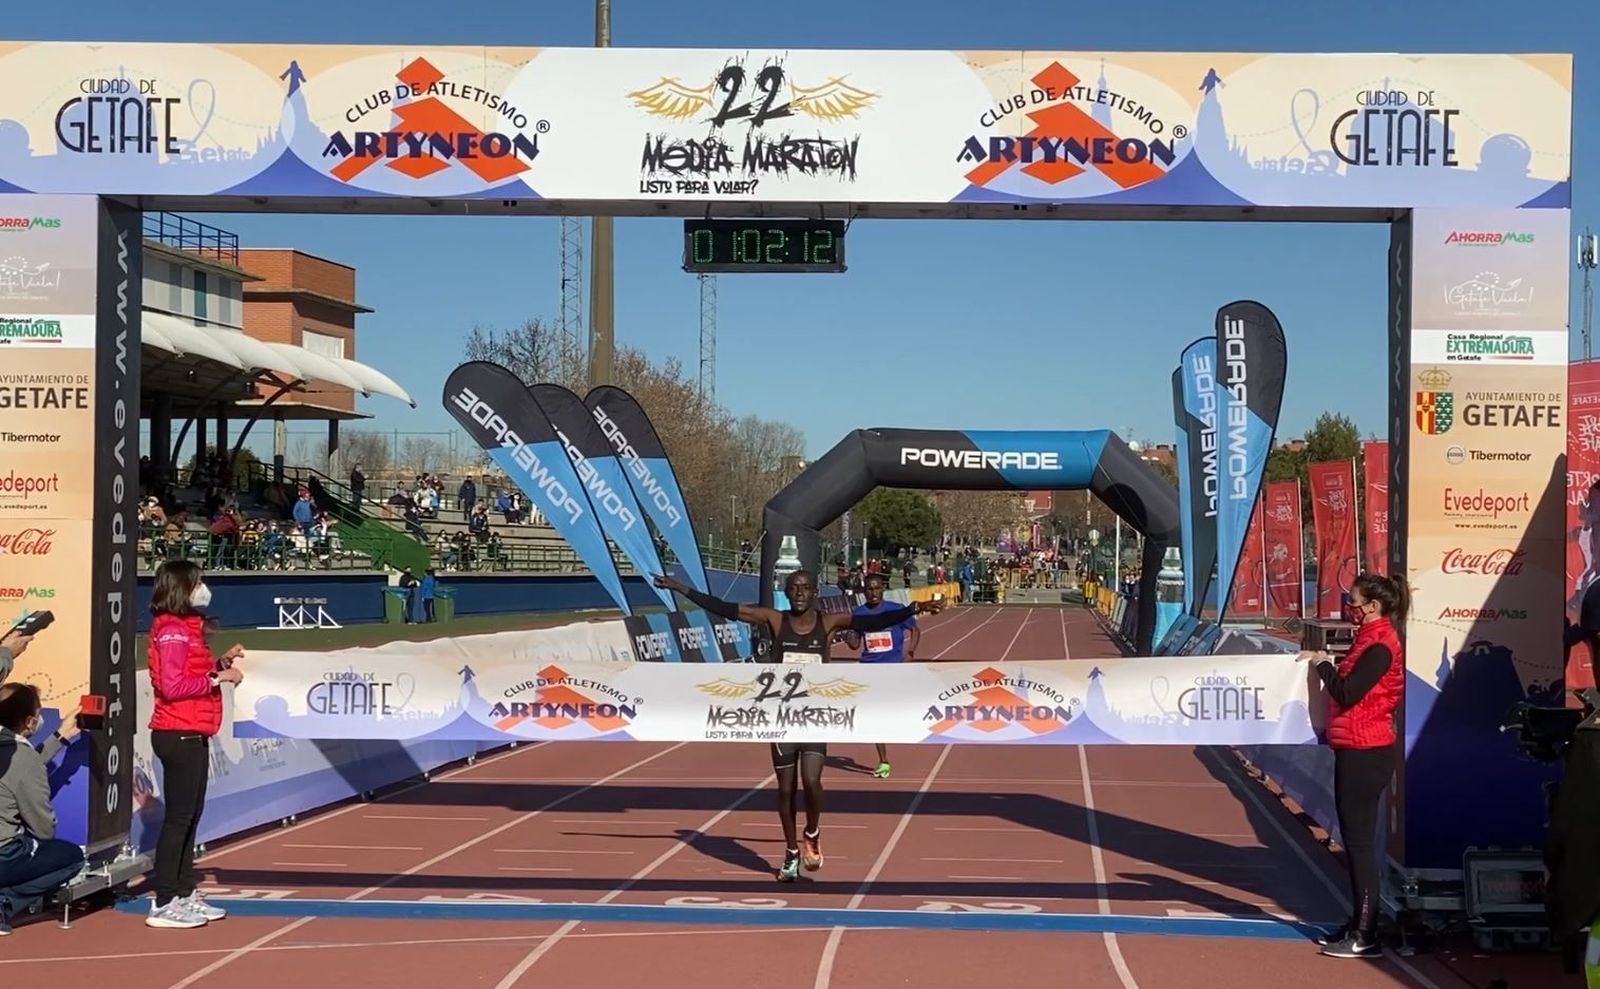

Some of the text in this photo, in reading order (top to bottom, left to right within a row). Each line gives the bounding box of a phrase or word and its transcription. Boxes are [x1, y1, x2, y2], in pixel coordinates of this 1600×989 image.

[80, 78, 156, 94] CIUDAD DE
[710, 56, 796, 128] 22
[1356, 91, 1435, 106] CIUDAD DE
[346, 81, 527, 129] CLUB DE ATLETISMO
[980, 86, 1164, 134] CLUB DE ATLETISMO
[55, 97, 181, 154] GETAFE
[1330, 109, 1460, 166] GETAFE
[322, 130, 540, 160] ARTYNEON
[742, 134, 861, 180] MARATON
[956, 135, 1177, 166] ARTYNEON
[640, 179, 760, 195] LISTO PARA VOLAR?
[1446, 340, 1534, 354] EXTREMADURA
[1469, 333, 1503, 341] Regional
[77, 376, 89, 384] DE
[0, 387, 88, 409] GETAFE
[1465, 392, 1561, 402] AYUNTAMIENTO DE
[1463, 404, 1560, 427] GETAFE
[1, 432, 61, 443] Tibermotor
[901, 447, 1060, 470] POWERADE
[1469, 450, 1531, 461] Tibermotor
[0, 469, 58, 500] deport
[1444, 487, 1529, 519] Evedeport
[106, 229, 130, 814] www.evedeport.es
[1441, 548, 1528, 576] Coca-Cola
[307, 682, 392, 715] GETAFE
[504, 677, 628, 703] CLUB DE ATLETISMO
[752, 669, 810, 702] 22
[938, 678, 1065, 704] CLUB DE ATLETISMO
[488, 701, 637, 720] ARTYNEON
[922, 704, 1073, 722] ARTYNEON
[1178, 687, 1265, 720] GETAFE
[776, 704, 856, 730] MARATON
